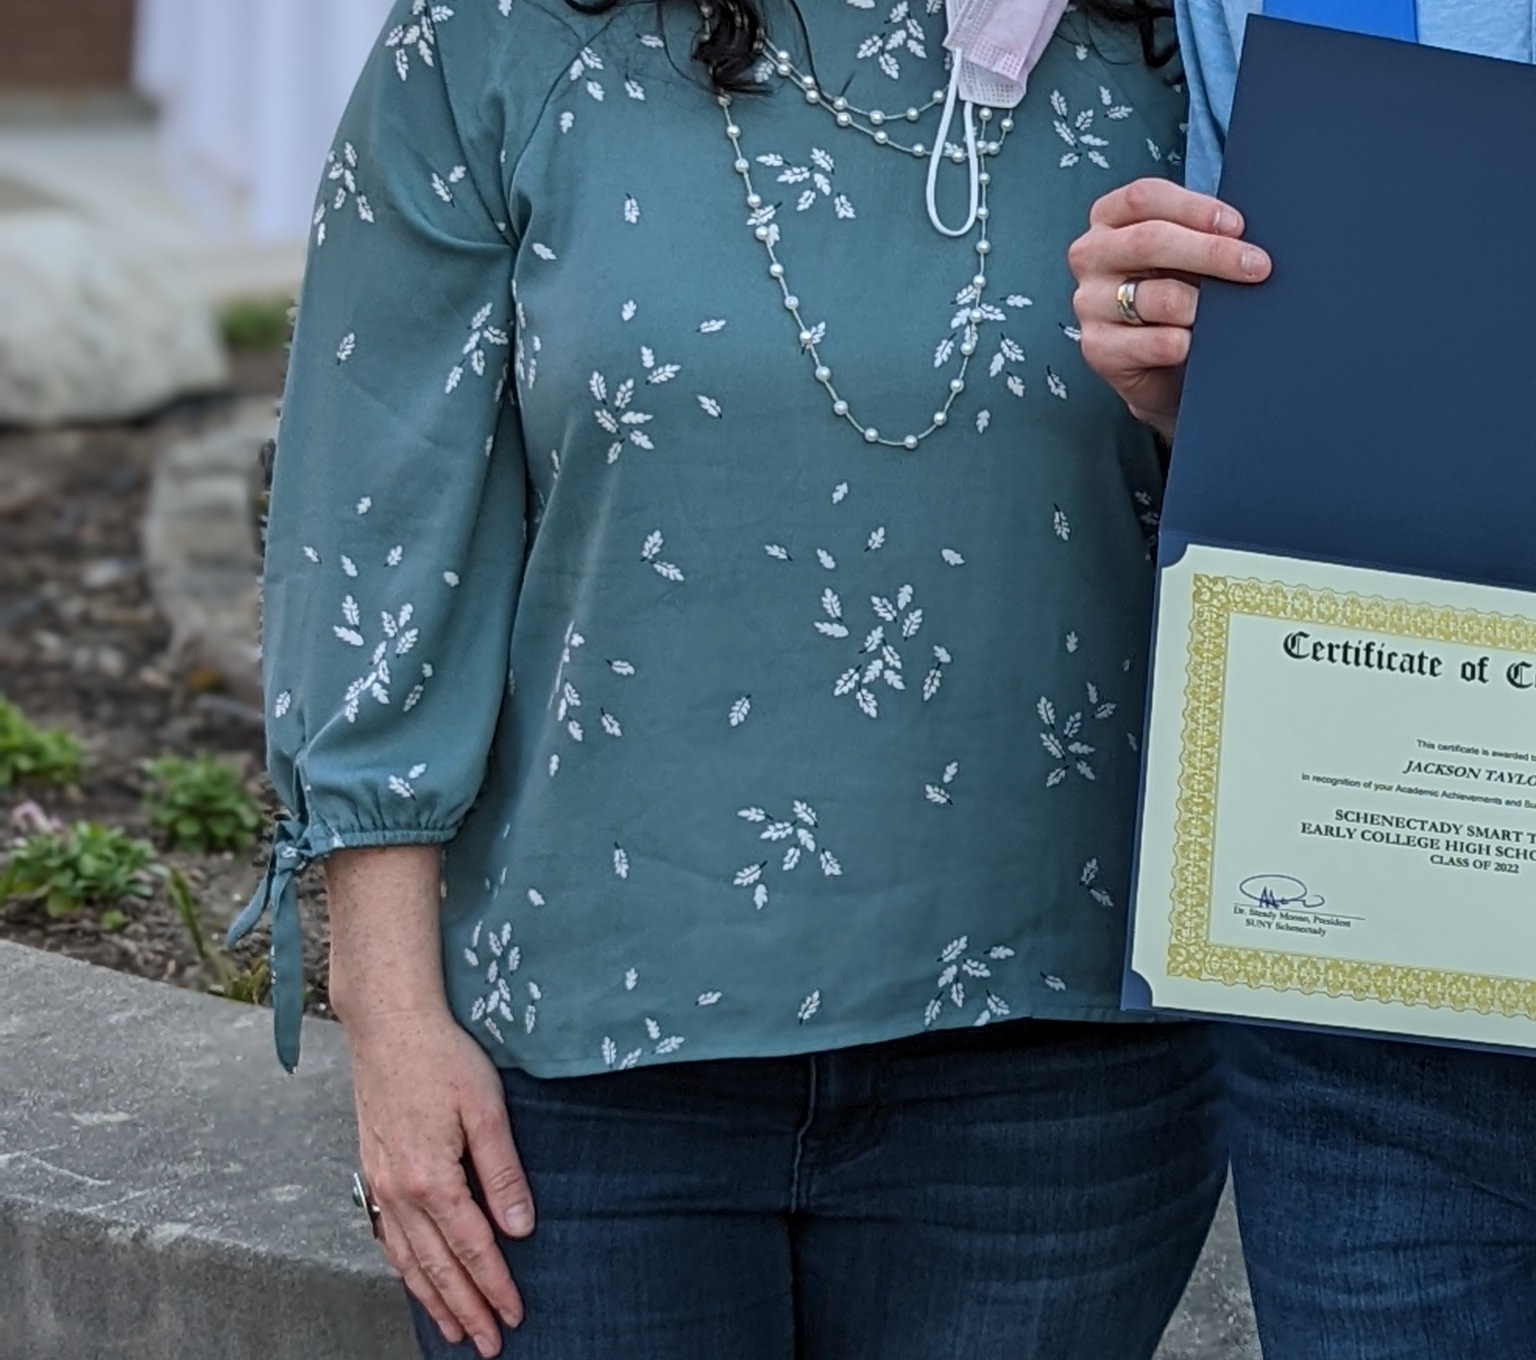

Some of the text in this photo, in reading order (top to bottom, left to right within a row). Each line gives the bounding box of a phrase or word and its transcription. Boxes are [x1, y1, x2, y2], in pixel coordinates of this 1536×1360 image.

[1282, 630, 1443, 677] Certificate
[1460, 656, 1489, 683] of
[1417, 739, 1435, 749] This
[1437, 742, 1480, 755] certificate
[1482, 747, 1489, 756] is
[1491, 749, 1529, 761] awarded
[1402, 760, 1482, 779] JACKSON
[1312, 774, 1361, 787] recognition
[1363, 780, 1373, 789] of
[1374, 783, 1394, 792] your
[1395, 784, 1439, 797] Academic
[1441, 790, 1502, 805] Achievements
[1504, 798, 1522, 807] and
[1335, 809, 1464, 835] SCHENECTADY
[1466, 825, 1524, 842] SMART
[1300, 822, 1357, 839] EARLY
[1360, 829, 1441, 850] COLLEGE
[1445, 839, 1491, 856] HIGH
[1430, 854, 1520, 873] CLASS OF 2022
[1233, 906, 1247, 915] Dr.
[1313, 915, 1351, 927] President
[1245, 919, 1327, 937] SUNY Schenectady
